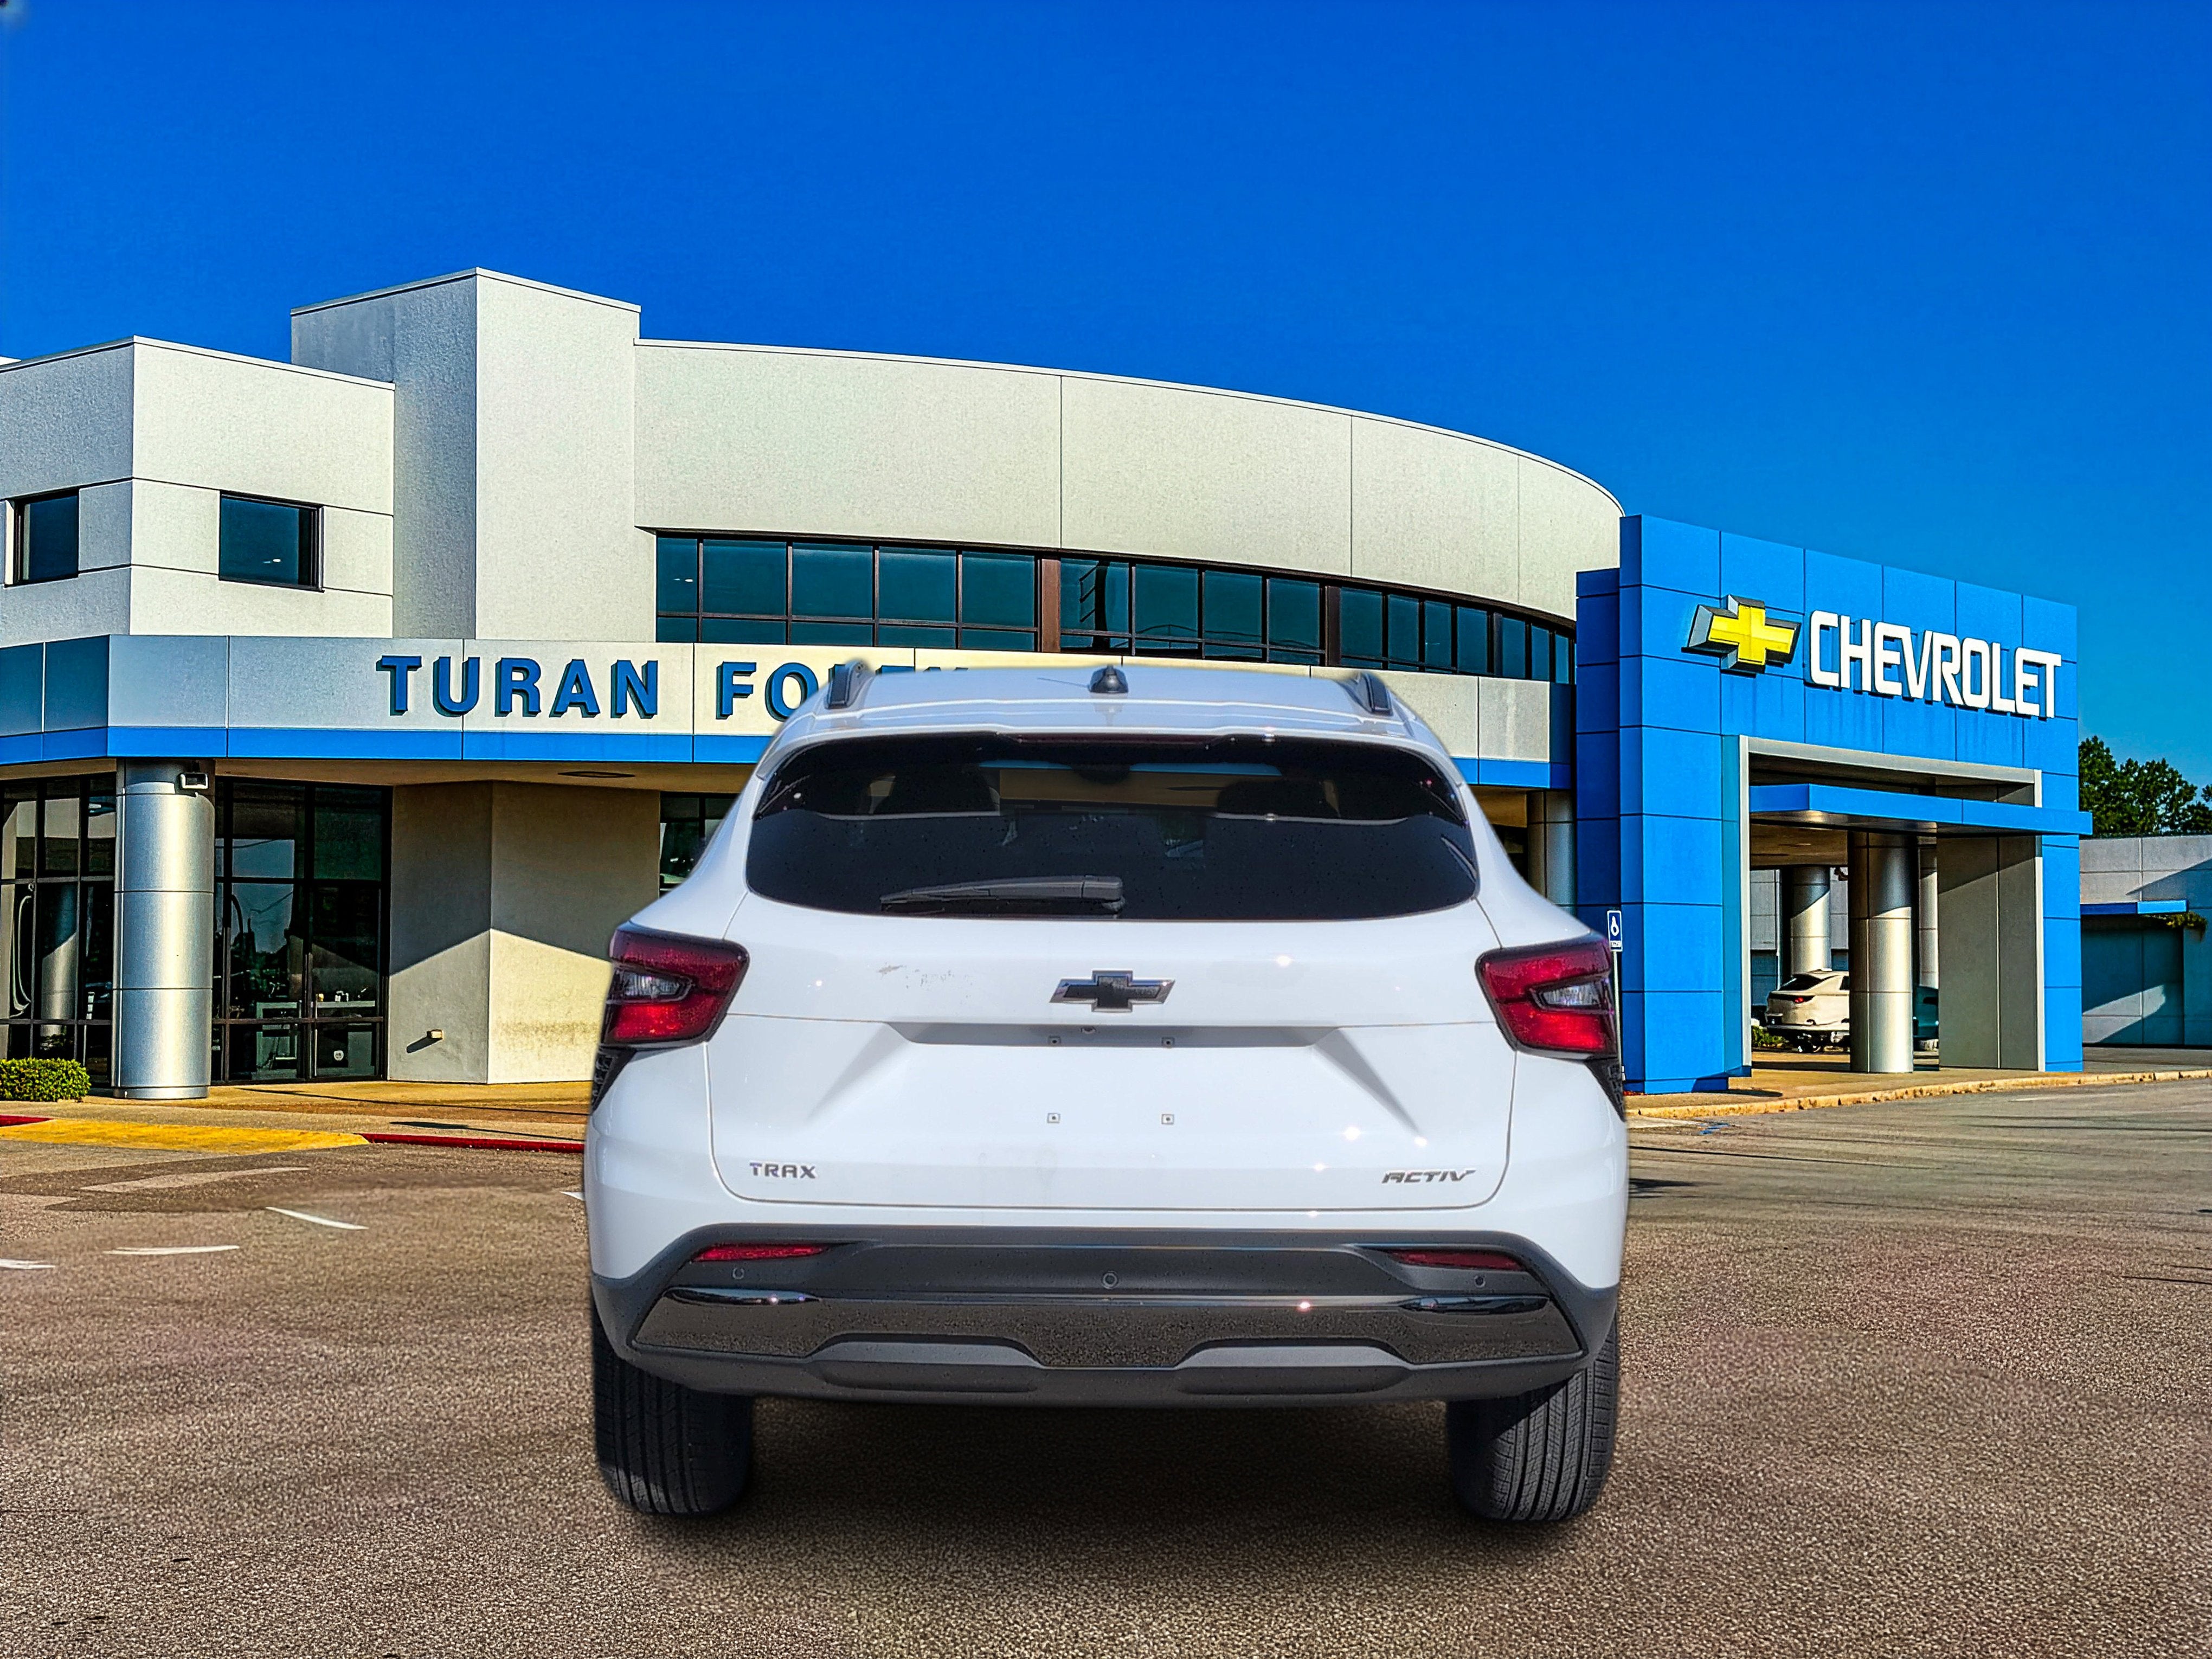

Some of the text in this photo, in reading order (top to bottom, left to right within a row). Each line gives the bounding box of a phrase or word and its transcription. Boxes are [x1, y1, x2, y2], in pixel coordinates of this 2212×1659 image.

[1809, 610, 2062, 719] CHEVROLET
[376, 655, 659, 719] TURAN
[749, 1162, 816, 1179] TRAX
[1381, 1169, 1477, 1184] ACTIV
